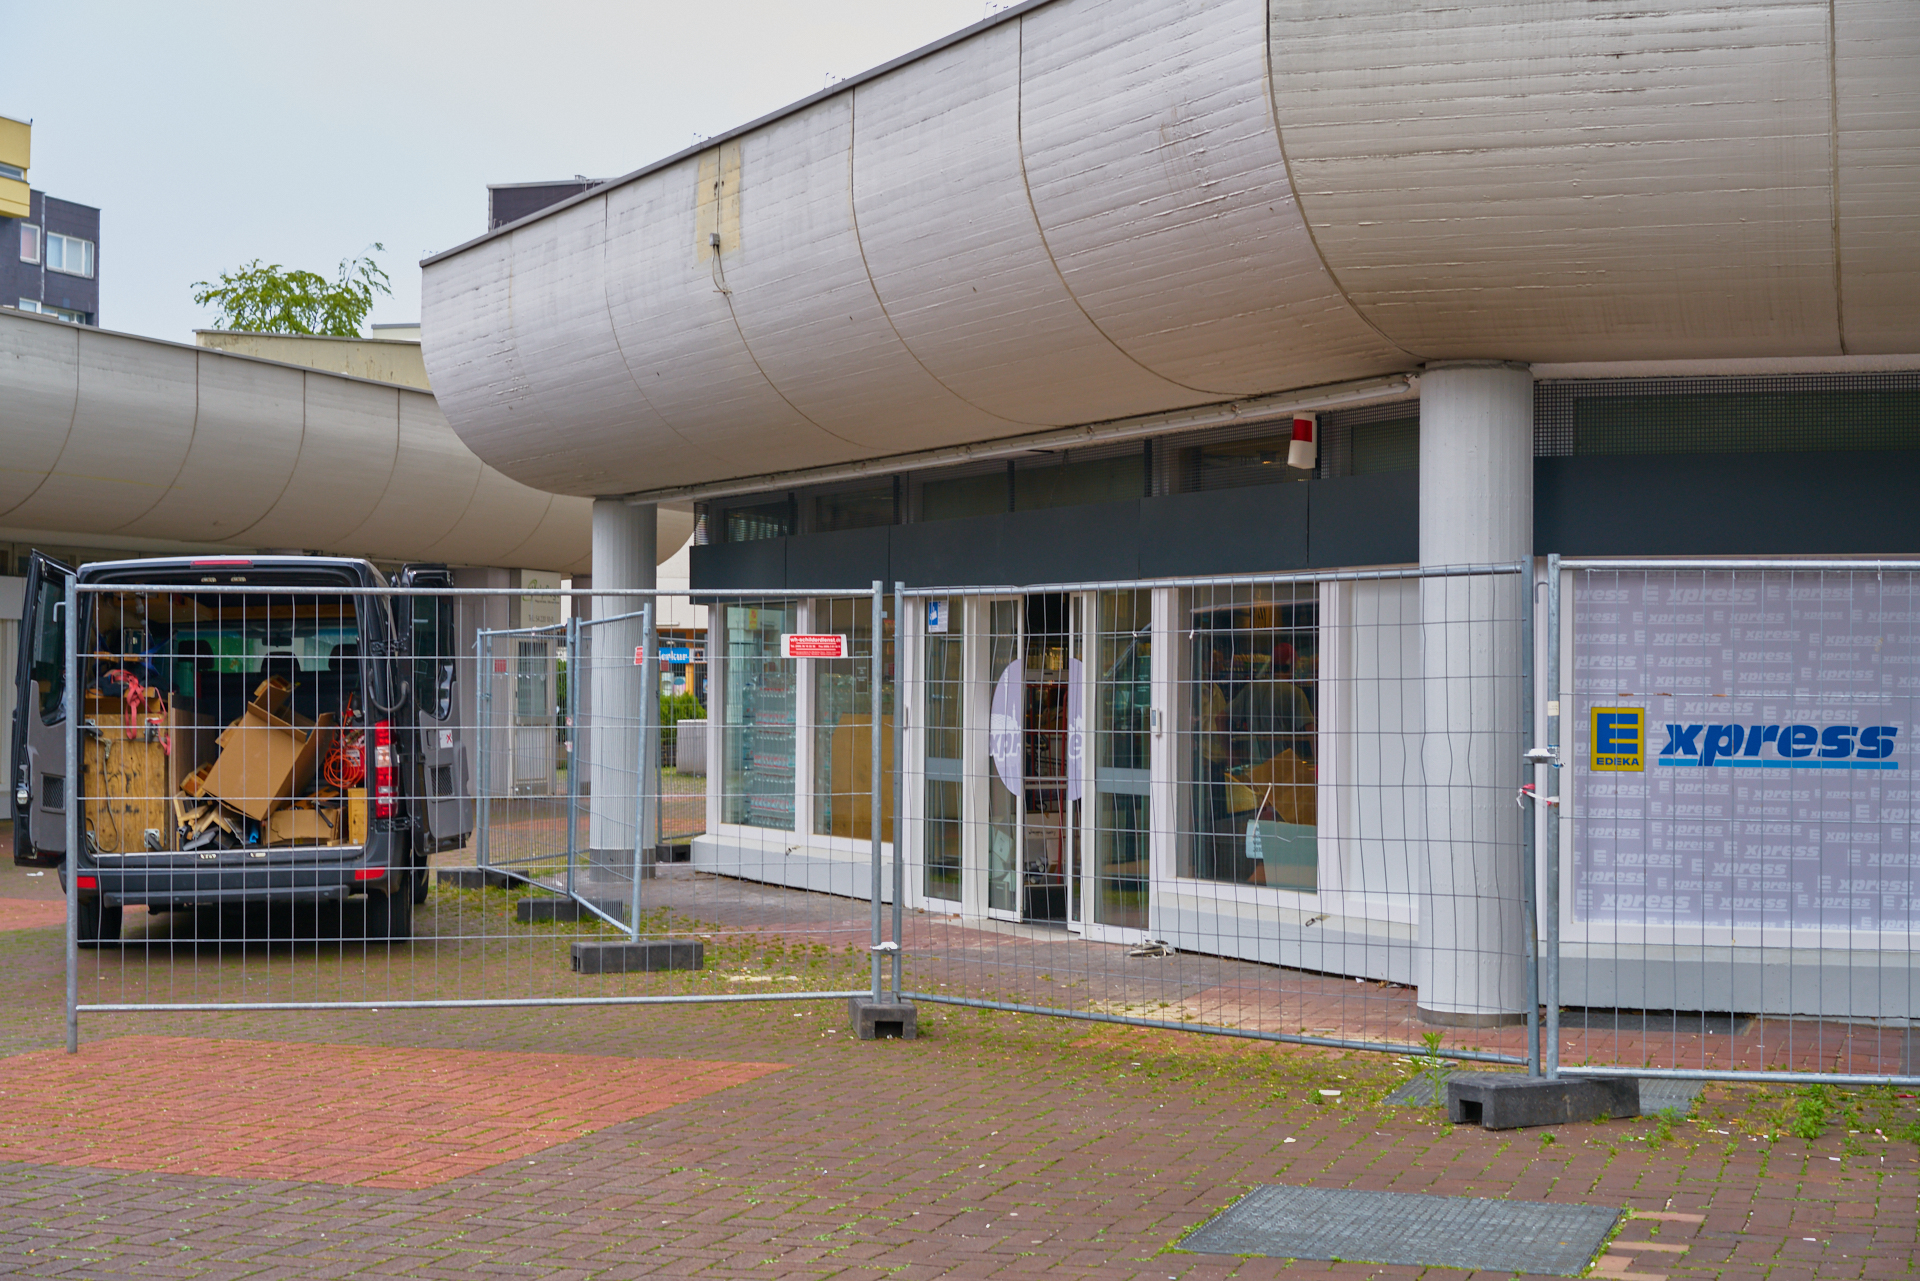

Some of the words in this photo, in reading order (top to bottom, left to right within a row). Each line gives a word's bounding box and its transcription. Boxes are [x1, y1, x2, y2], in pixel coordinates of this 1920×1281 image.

[1667, 589, 1756, 604] xpress
[1786, 589, 1855, 600] xpress
[1648, 614, 1704, 624] xpress
[1729, 613, 1785, 623] xpress
[1802, 612, 1843, 620] xpress
[1653, 633, 1721, 645] xpress
[1745, 631, 1801, 641] xpress
[1825, 636, 1881, 647] xpress
[1658, 657, 1712, 667] xpress
[1738, 652, 1792, 663] xpress
[1820, 653, 1860, 661] xpress
[1738, 672, 1793, 683] xpress
[1817, 670, 1874, 681] xpress
[1655, 676, 1711, 687] xpress
[1816, 692, 1890, 704] xpress
[1683, 702, 1754, 715] xpress
[1783, 709, 1859, 723] xpress
[1597, 713, 1638, 754] E
[1660, 724, 1898, 766] xpress
[1597, 757, 1640, 766] EDEKA
[1652, 768, 1708, 779] xpress
[1733, 769, 1790, 779] xpress
[1583, 784, 1651, 798] xpress
[1674, 783, 1730, 794] xpress
[1753, 790, 1810, 800] xpress
[1825, 791, 1866, 799] xpress
[1588, 808, 1641, 818] xpress
[1667, 804, 1722, 816] xpress
[1748, 806, 1788, 815] xpress
[1810, 810, 1850, 819] xpress
[1586, 827, 1640, 838] xpress
[1667, 824, 1723, 836] xpress
[1745, 824, 1801, 835] xpress
[1825, 831, 1882, 843] xpress
[1667, 841, 1714, 850] xpress
[1744, 845, 1820, 859] xpress
[1613, 853, 1682, 867] xpress
[1712, 862, 1786, 877] xpress
[1580, 871, 1647, 885] xpress
[1672, 880, 1722, 891] xpress
[1752, 881, 1803, 891] xpress
[1838, 879, 1914, 894] xpress
[1602, 894, 1690, 911] xpress
[1719, 897, 1787, 910] xpress
[1813, 897, 1870, 909] xpress
